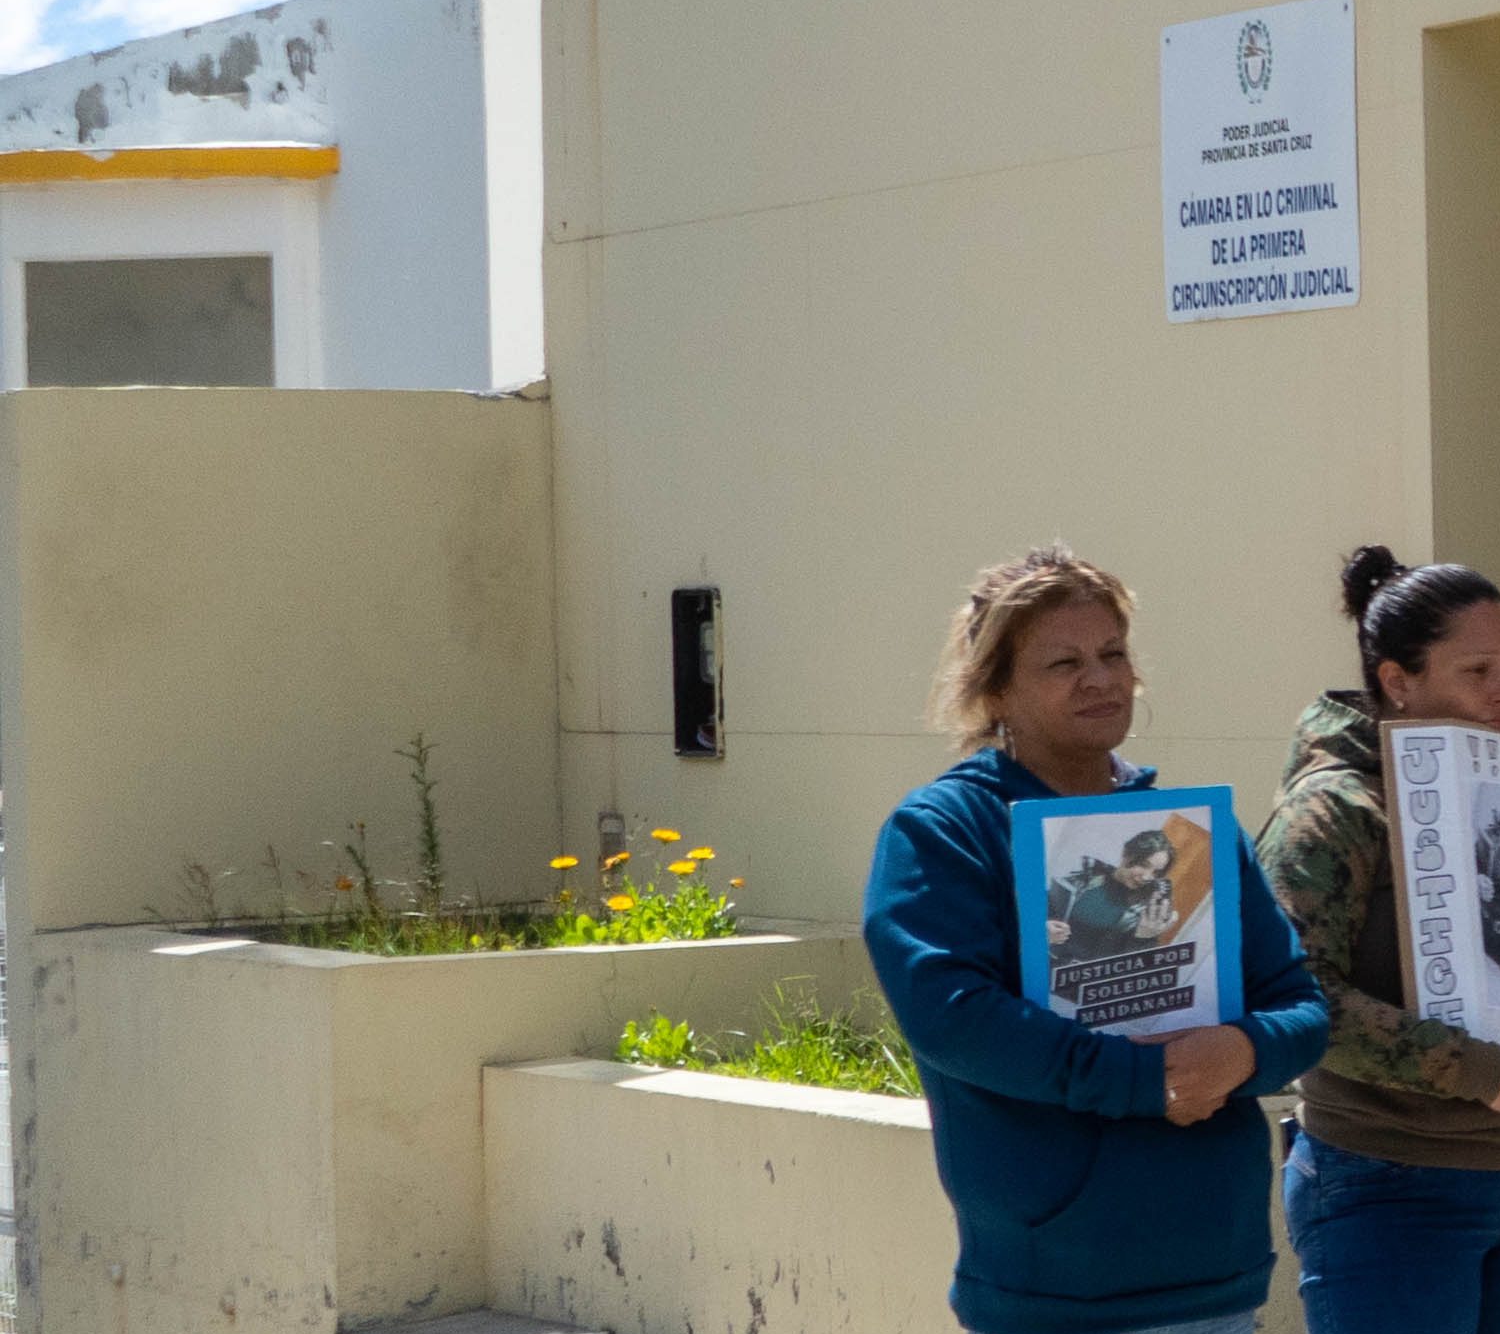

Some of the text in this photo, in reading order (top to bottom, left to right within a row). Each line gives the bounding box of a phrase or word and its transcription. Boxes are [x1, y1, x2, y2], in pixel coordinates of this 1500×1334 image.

[1223, 118, 1290, 142] PODER JUDICIAL
[1202, 135, 1312, 164] PROVINCIA DE SANTA CRUZ
[1180, 183, 1338, 228] CÁMARA EN LO CRIMINAL
[1211, 229, 1306, 265] DE LA PRIMERA
[1172, 265, 1353, 312] CIRCUNSCRIPCIÓN JUDICIAL
[1402, 736, 1466, 1029] JUSTICI
[1058, 948, 1191, 987] JUSTICIA POR
[1086, 973, 1175, 1001] SOLEDAD
[1080, 990, 1191, 1025] MAIDANA!!!
